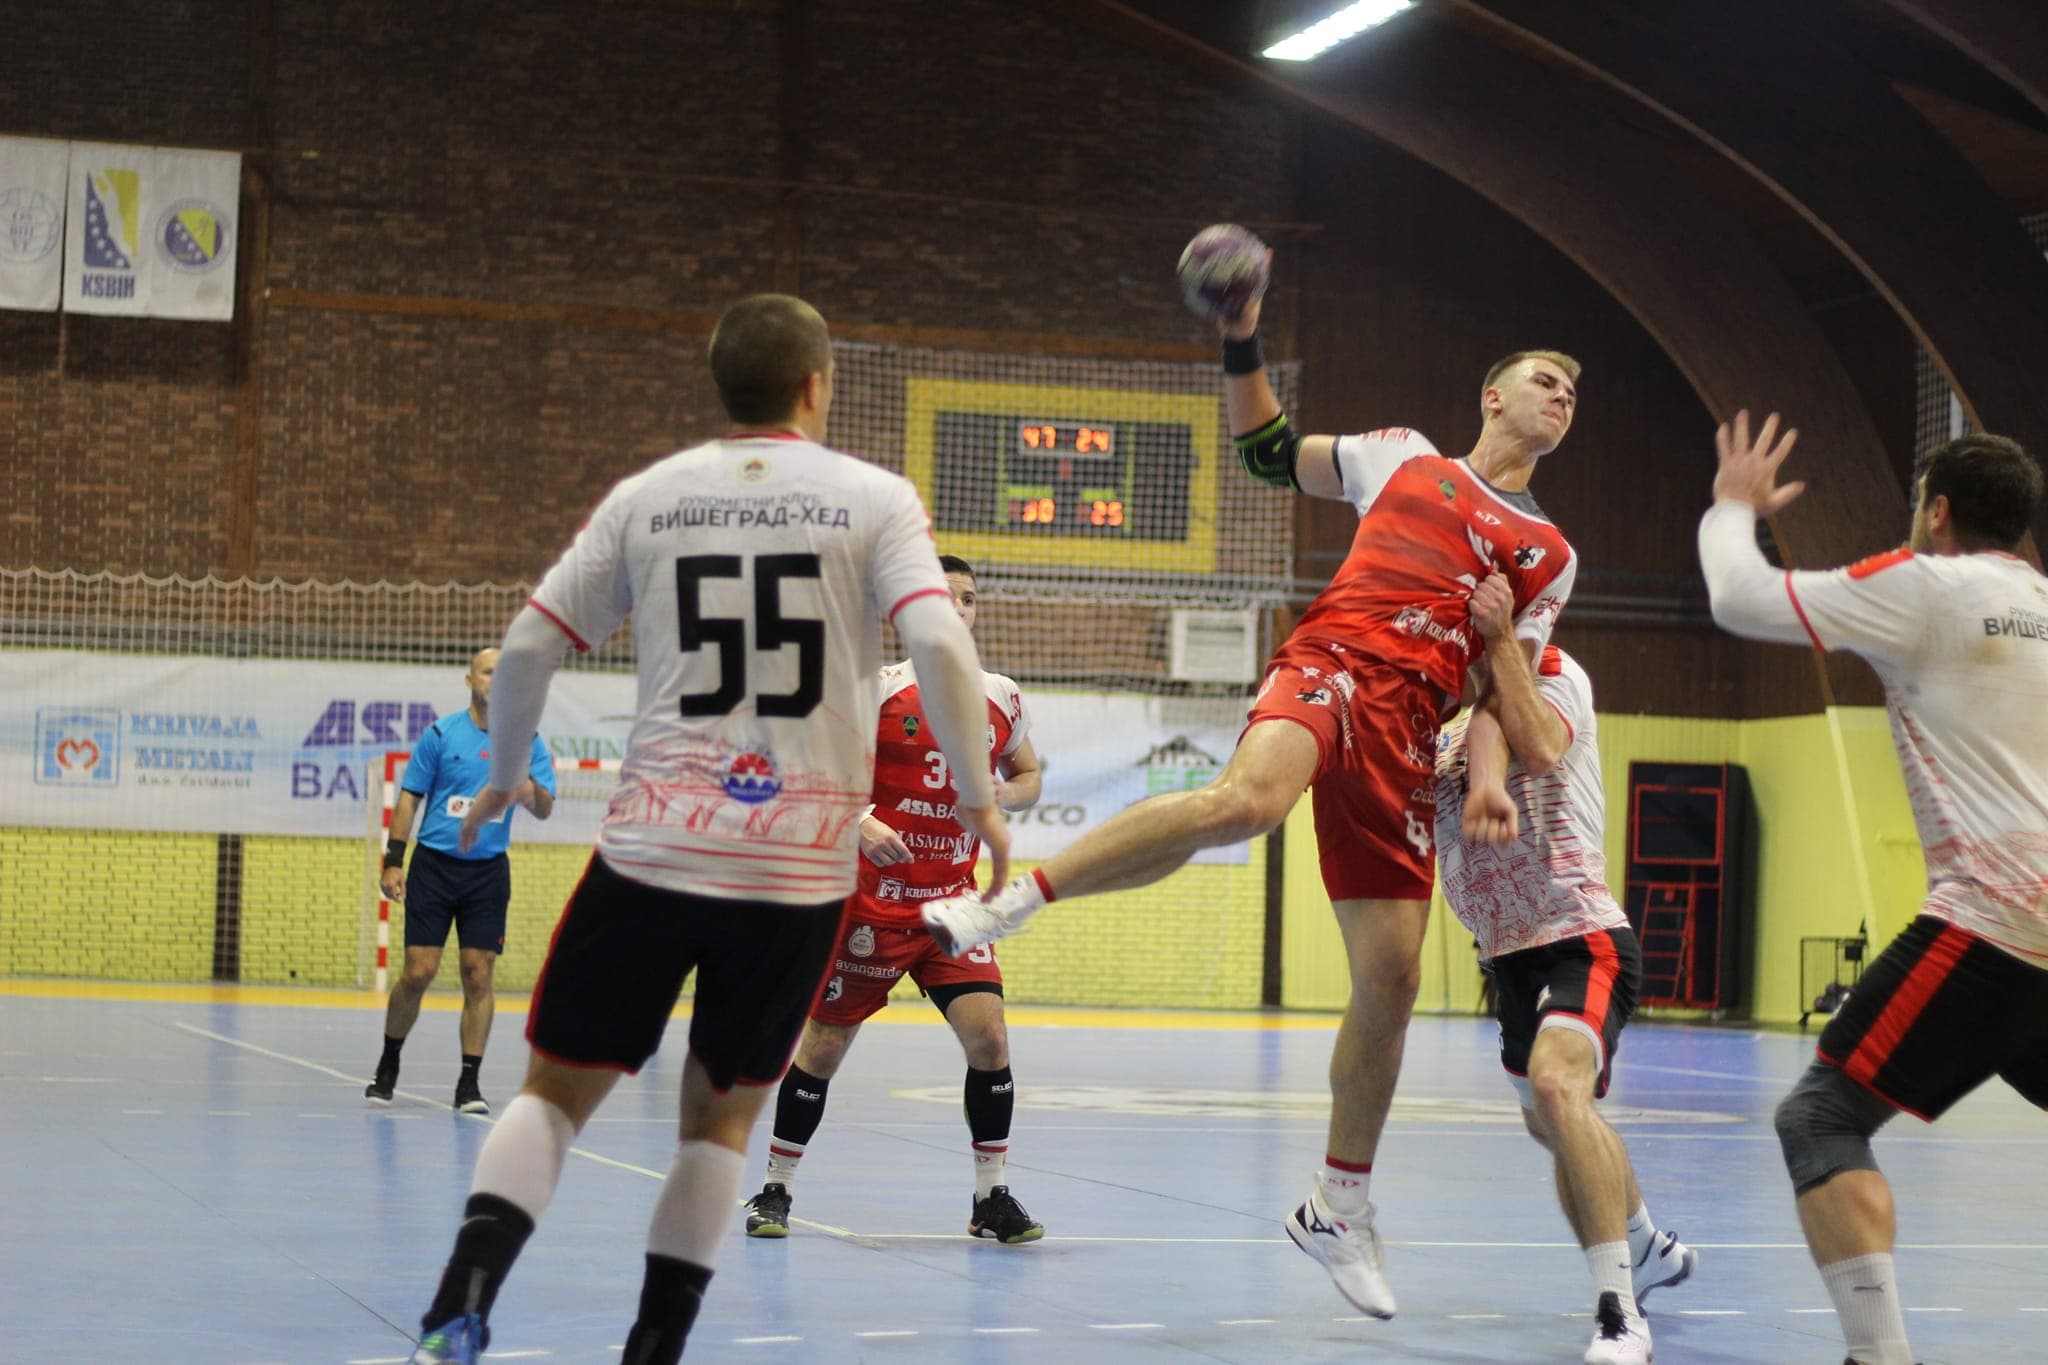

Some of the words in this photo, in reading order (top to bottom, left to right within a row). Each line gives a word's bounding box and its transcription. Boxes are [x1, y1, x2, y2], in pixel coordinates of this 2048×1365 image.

[81, 273, 135, 299] KSBIH
[651, 504, 850, 534] ВИШЕГРАД-ХЕД
[675, 553, 826, 718] 55
[290, 761, 368, 801] BA
[923, 750, 959, 791] 3
[935, 803, 959, 820] BA
[835, 958, 904, 978] avangarde
